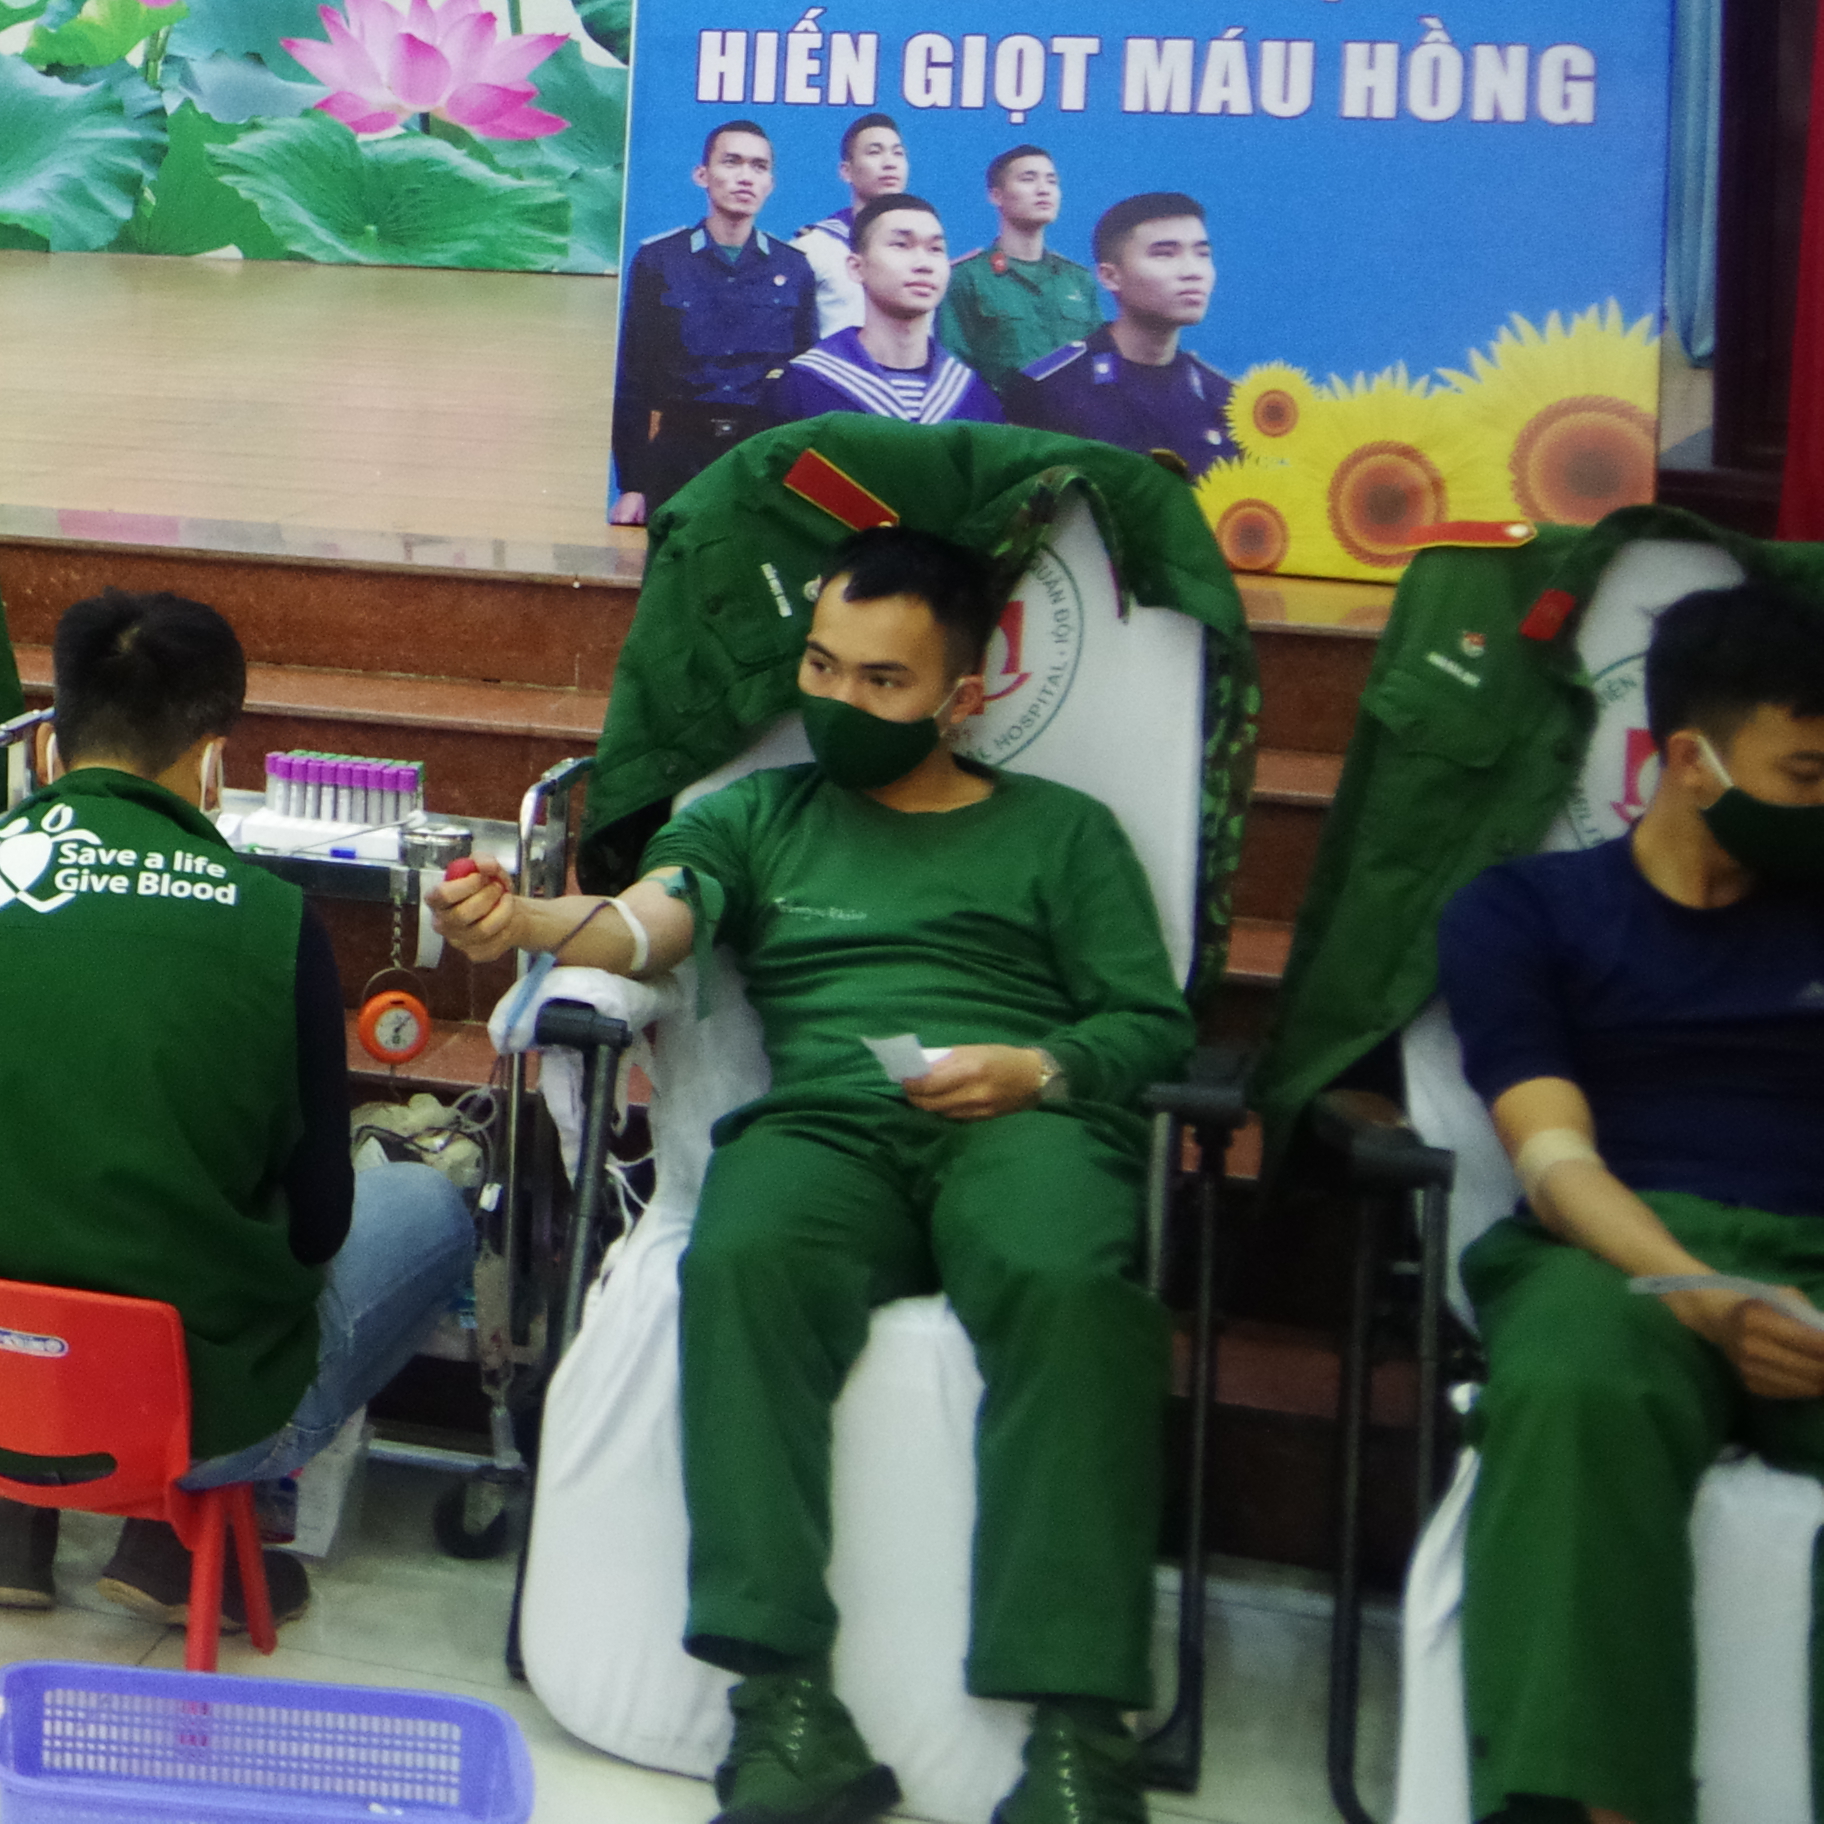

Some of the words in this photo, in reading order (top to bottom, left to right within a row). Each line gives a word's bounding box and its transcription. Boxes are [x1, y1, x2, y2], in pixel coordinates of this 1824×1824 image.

[695, 6, 878, 107] HIẾN
[901, 33, 1102, 124] GIỌT
[1122, 27, 1315, 117] MÁU
[1340, 15, 1597, 125] HỒNG
[994, 660, 1069, 750] HOSPITAL
[54, 868, 129, 894] Give
[137, 872, 237, 906] Blood
[58, 842, 137, 866] Save
[144, 852, 165, 869] a
[173, 850, 227, 878] life
